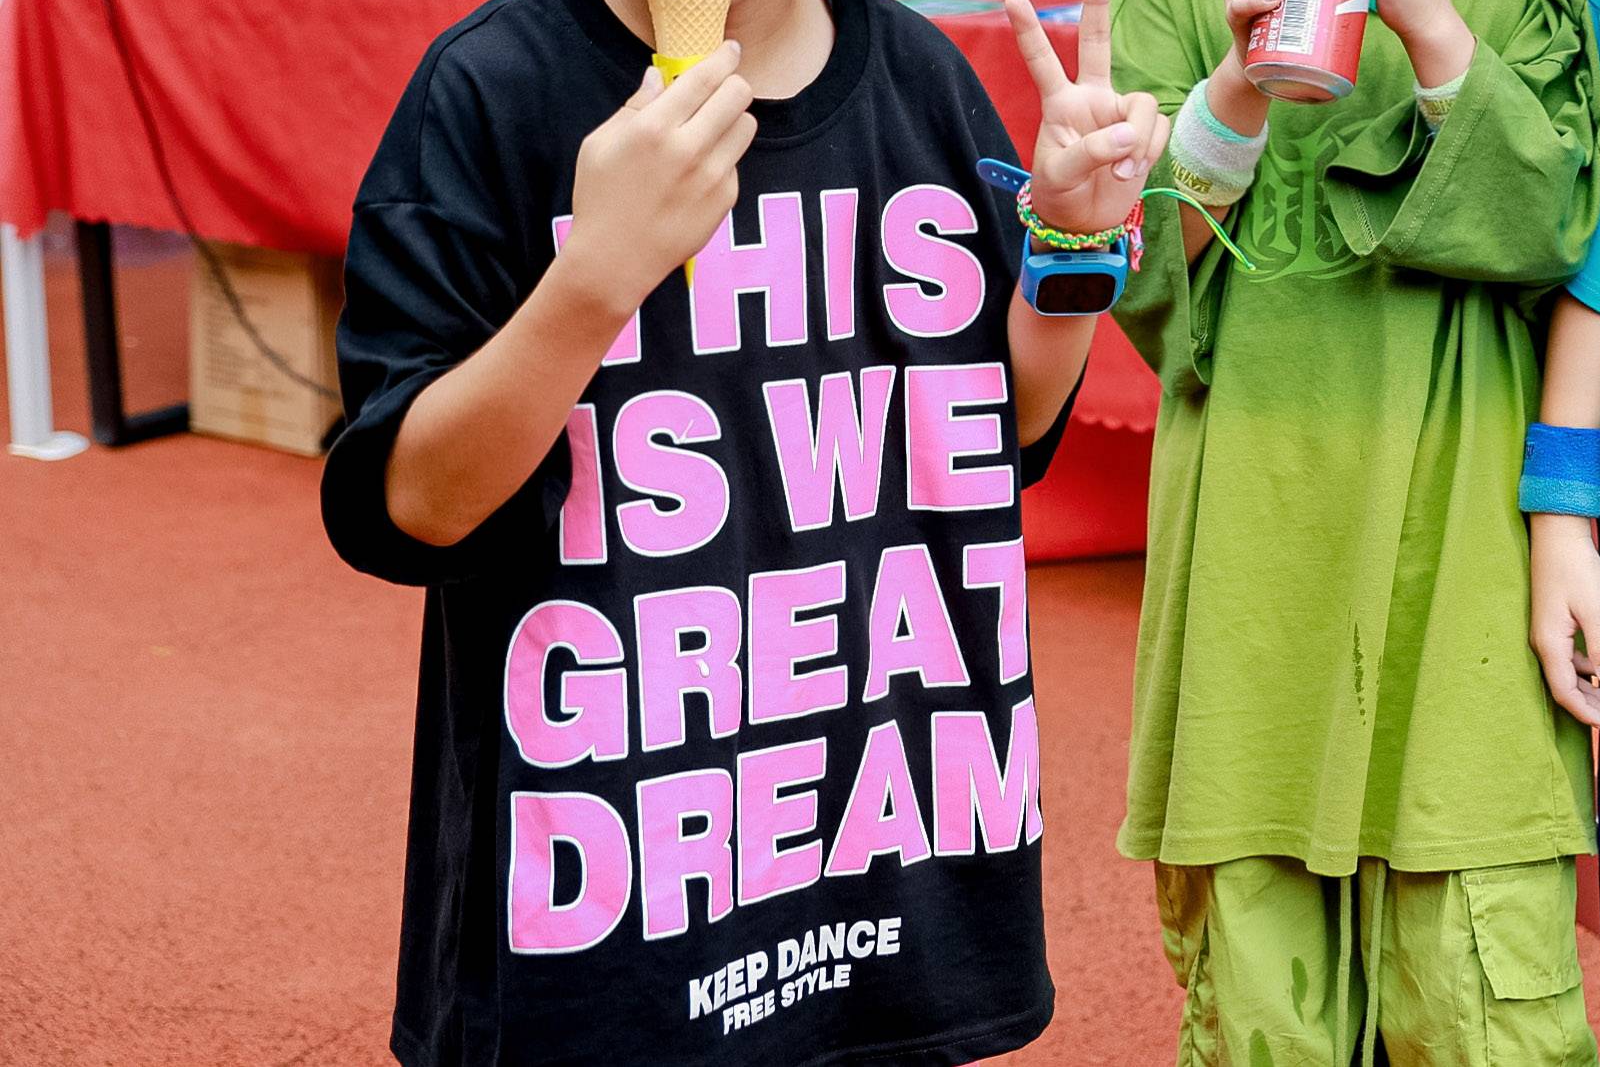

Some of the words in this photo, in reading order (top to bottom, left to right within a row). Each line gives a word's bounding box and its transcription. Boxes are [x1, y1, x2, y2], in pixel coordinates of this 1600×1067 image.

[559, 389, 730, 566] IS
[762, 363, 1015, 532] WE
[504, 536, 1029, 769] GREAT
[509, 695, 1043, 953] DREAM
[689, 950, 769, 1021] KEEP
[778, 916, 902, 981] DANCE
[723, 989, 775, 1035] FREE
[781, 963, 851, 1008] STYLE
